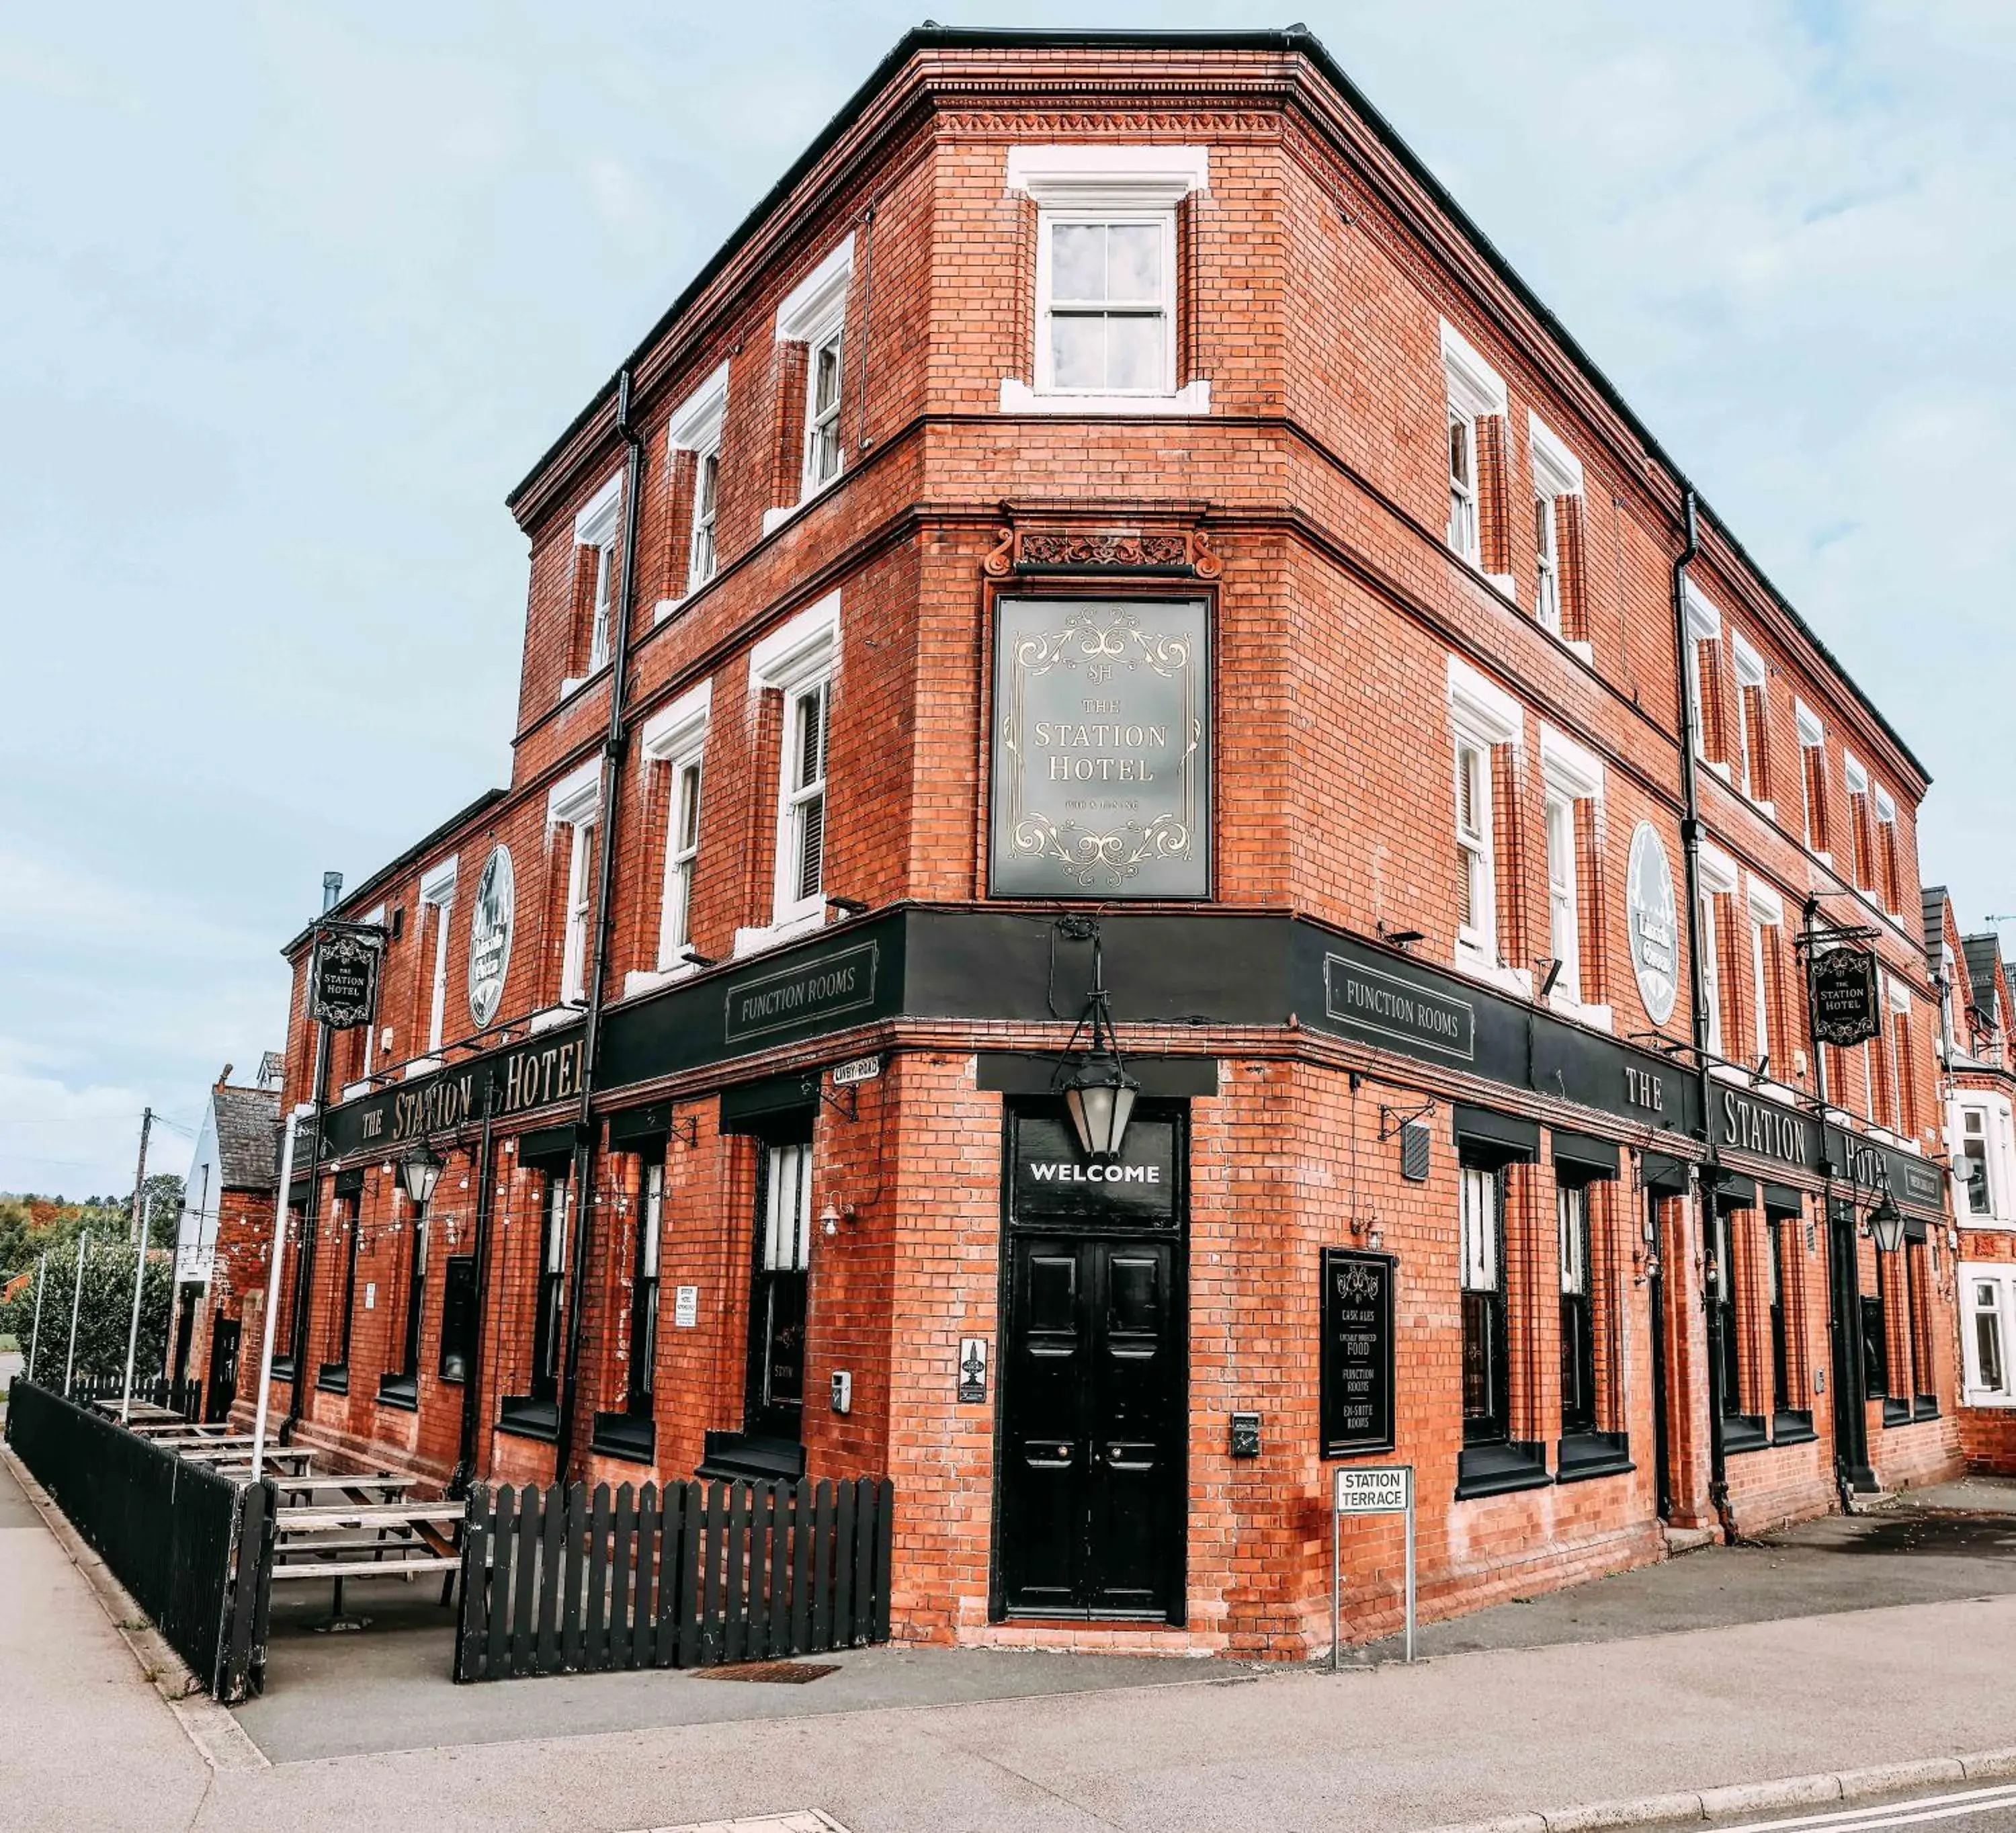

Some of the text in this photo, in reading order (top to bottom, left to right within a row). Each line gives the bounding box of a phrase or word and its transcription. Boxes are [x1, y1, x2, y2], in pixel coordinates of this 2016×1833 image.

[1083, 699, 1120, 714] THE
[1035, 722, 1167, 747] STATION
[1048, 756, 1154, 781] HOTEL
[324, 974, 365, 986] STATION
[327, 984, 360, 996] HOTEL
[742, 966, 855, 1022] FUNCTION ROOMS
[1820, 988, 1864, 1000] STATION
[1346, 980, 1458, 1037] FUNCTION ROOMS
[1826, 999, 1861, 1011] HOTEL
[362, 1040, 585, 1141] THE STATION HOTEL
[1626, 1066, 1663, 1111] THE
[1724, 1091, 1806, 1164] STATION
[1030, 1163, 1160, 1183] WELCOME
[1342, 1310, 1374, 1322] CASK ALES
[1347, 1342, 1370, 1355] FOOD
[1343, 1369, 1374, 1379] FUNCTION
[1347, 1381, 1369, 1392] ROOMS
[1343, 1404, 1374, 1417] EN-SUITE
[1347, 1417, 1369, 1429] ROOMS
[1345, 1472, 1400, 1488] STATION
[1342, 1490, 1402, 1506] TERRACE
